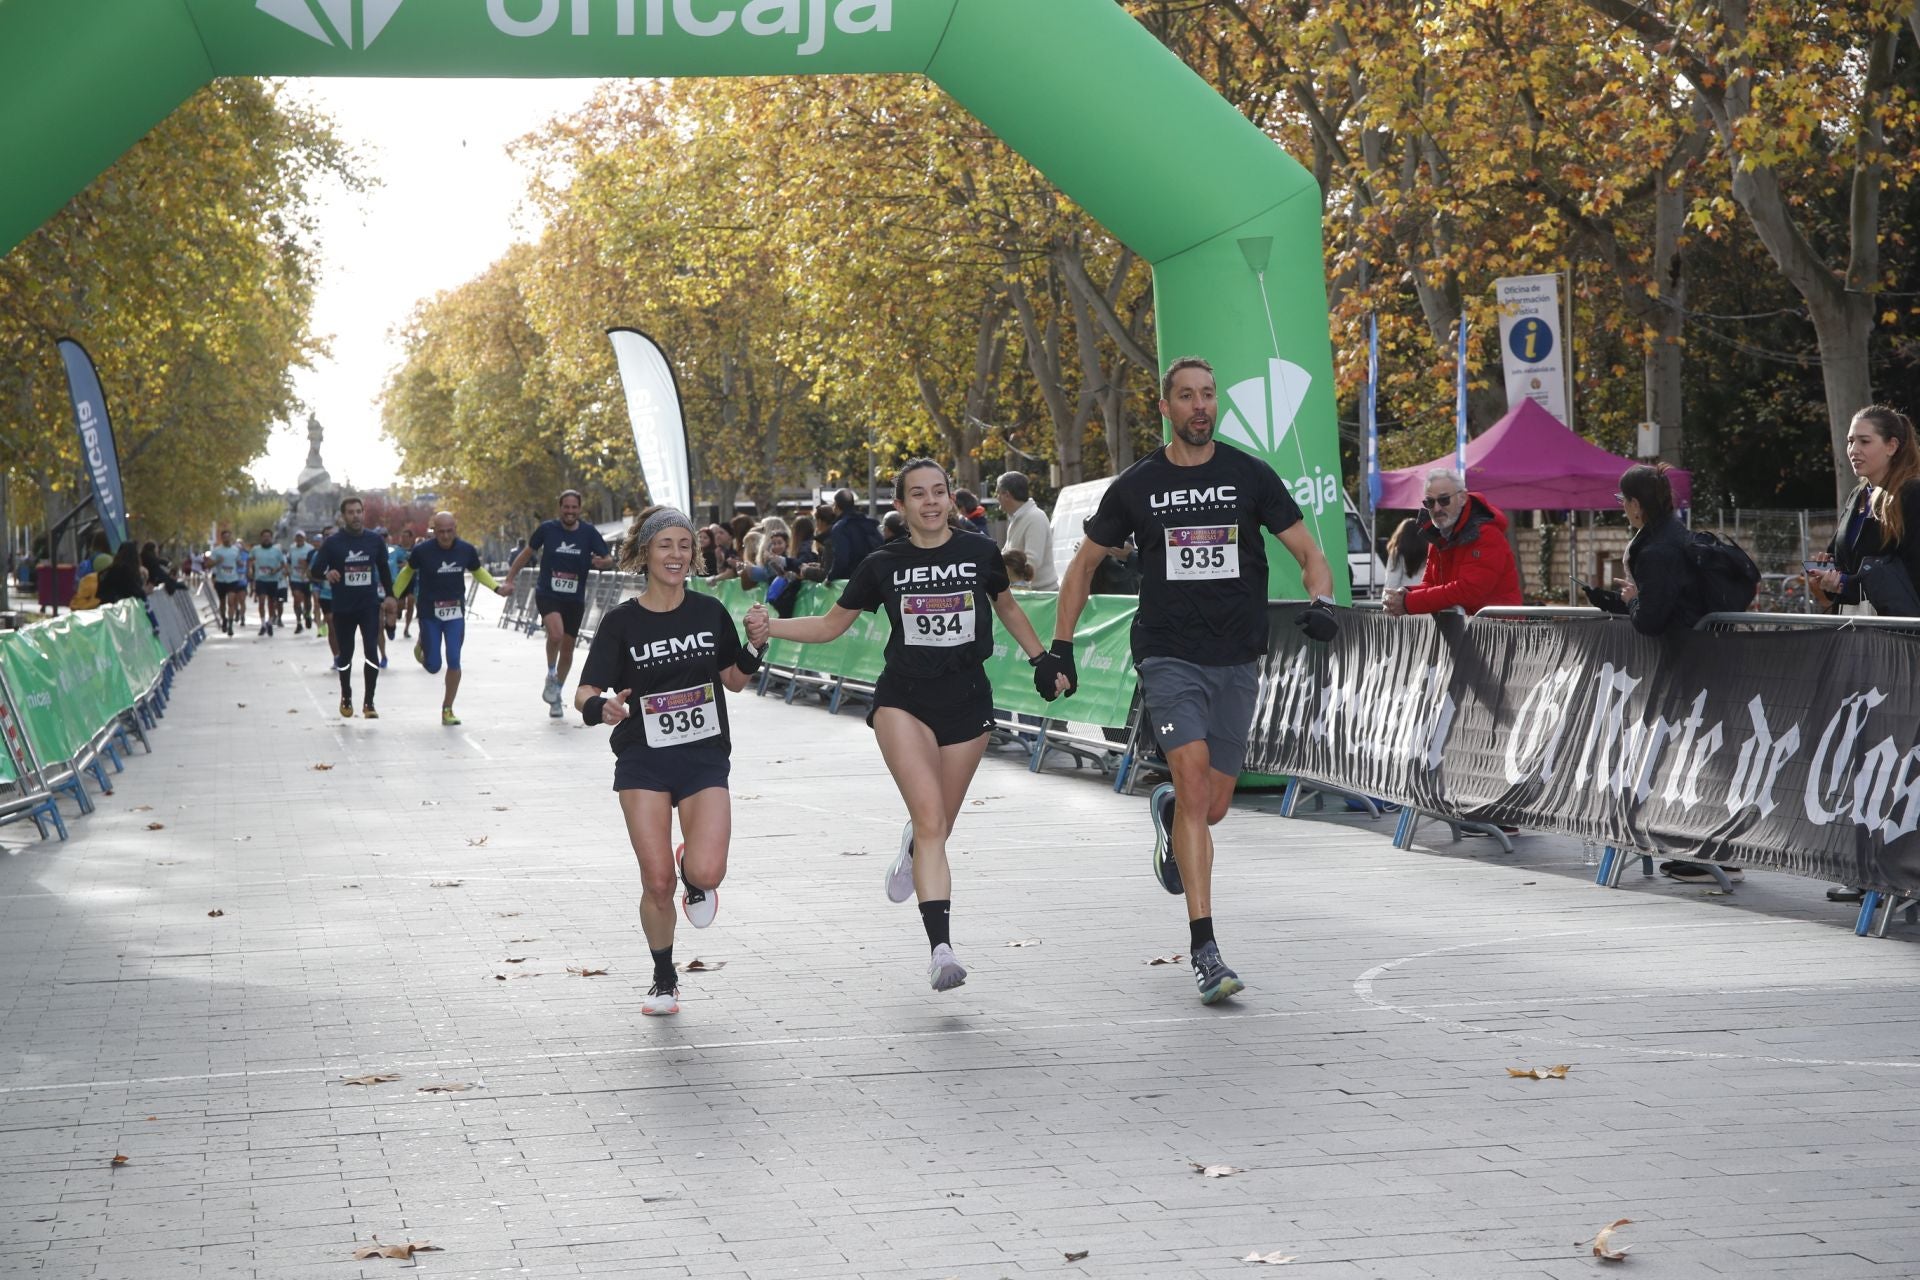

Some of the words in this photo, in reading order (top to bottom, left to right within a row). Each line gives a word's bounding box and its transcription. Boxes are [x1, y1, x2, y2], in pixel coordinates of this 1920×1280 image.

[1504, 285, 1530, 295] Oficina
[1531, 284, 1541, 292] de
[1150, 485, 1238, 508] UEMC
[1153, 503, 1237, 516] UNIVERSIDAD
[1180, 546, 1225, 569] 935
[348, 573, 367, 582] 679
[555, 580, 574, 589] 678
[893, 562, 977, 586] UEMC
[894, 580, 977, 592] UNIVERSIDAD
[438, 607, 456, 617] 677
[916, 613, 963, 636] 934
[629, 631, 715, 662] UEMC
[658, 707, 705, 735] 936
[1504, 664, 1583, 786] El
[1574, 662, 1724, 813] Norte
[1726, 693, 1801, 820] de
